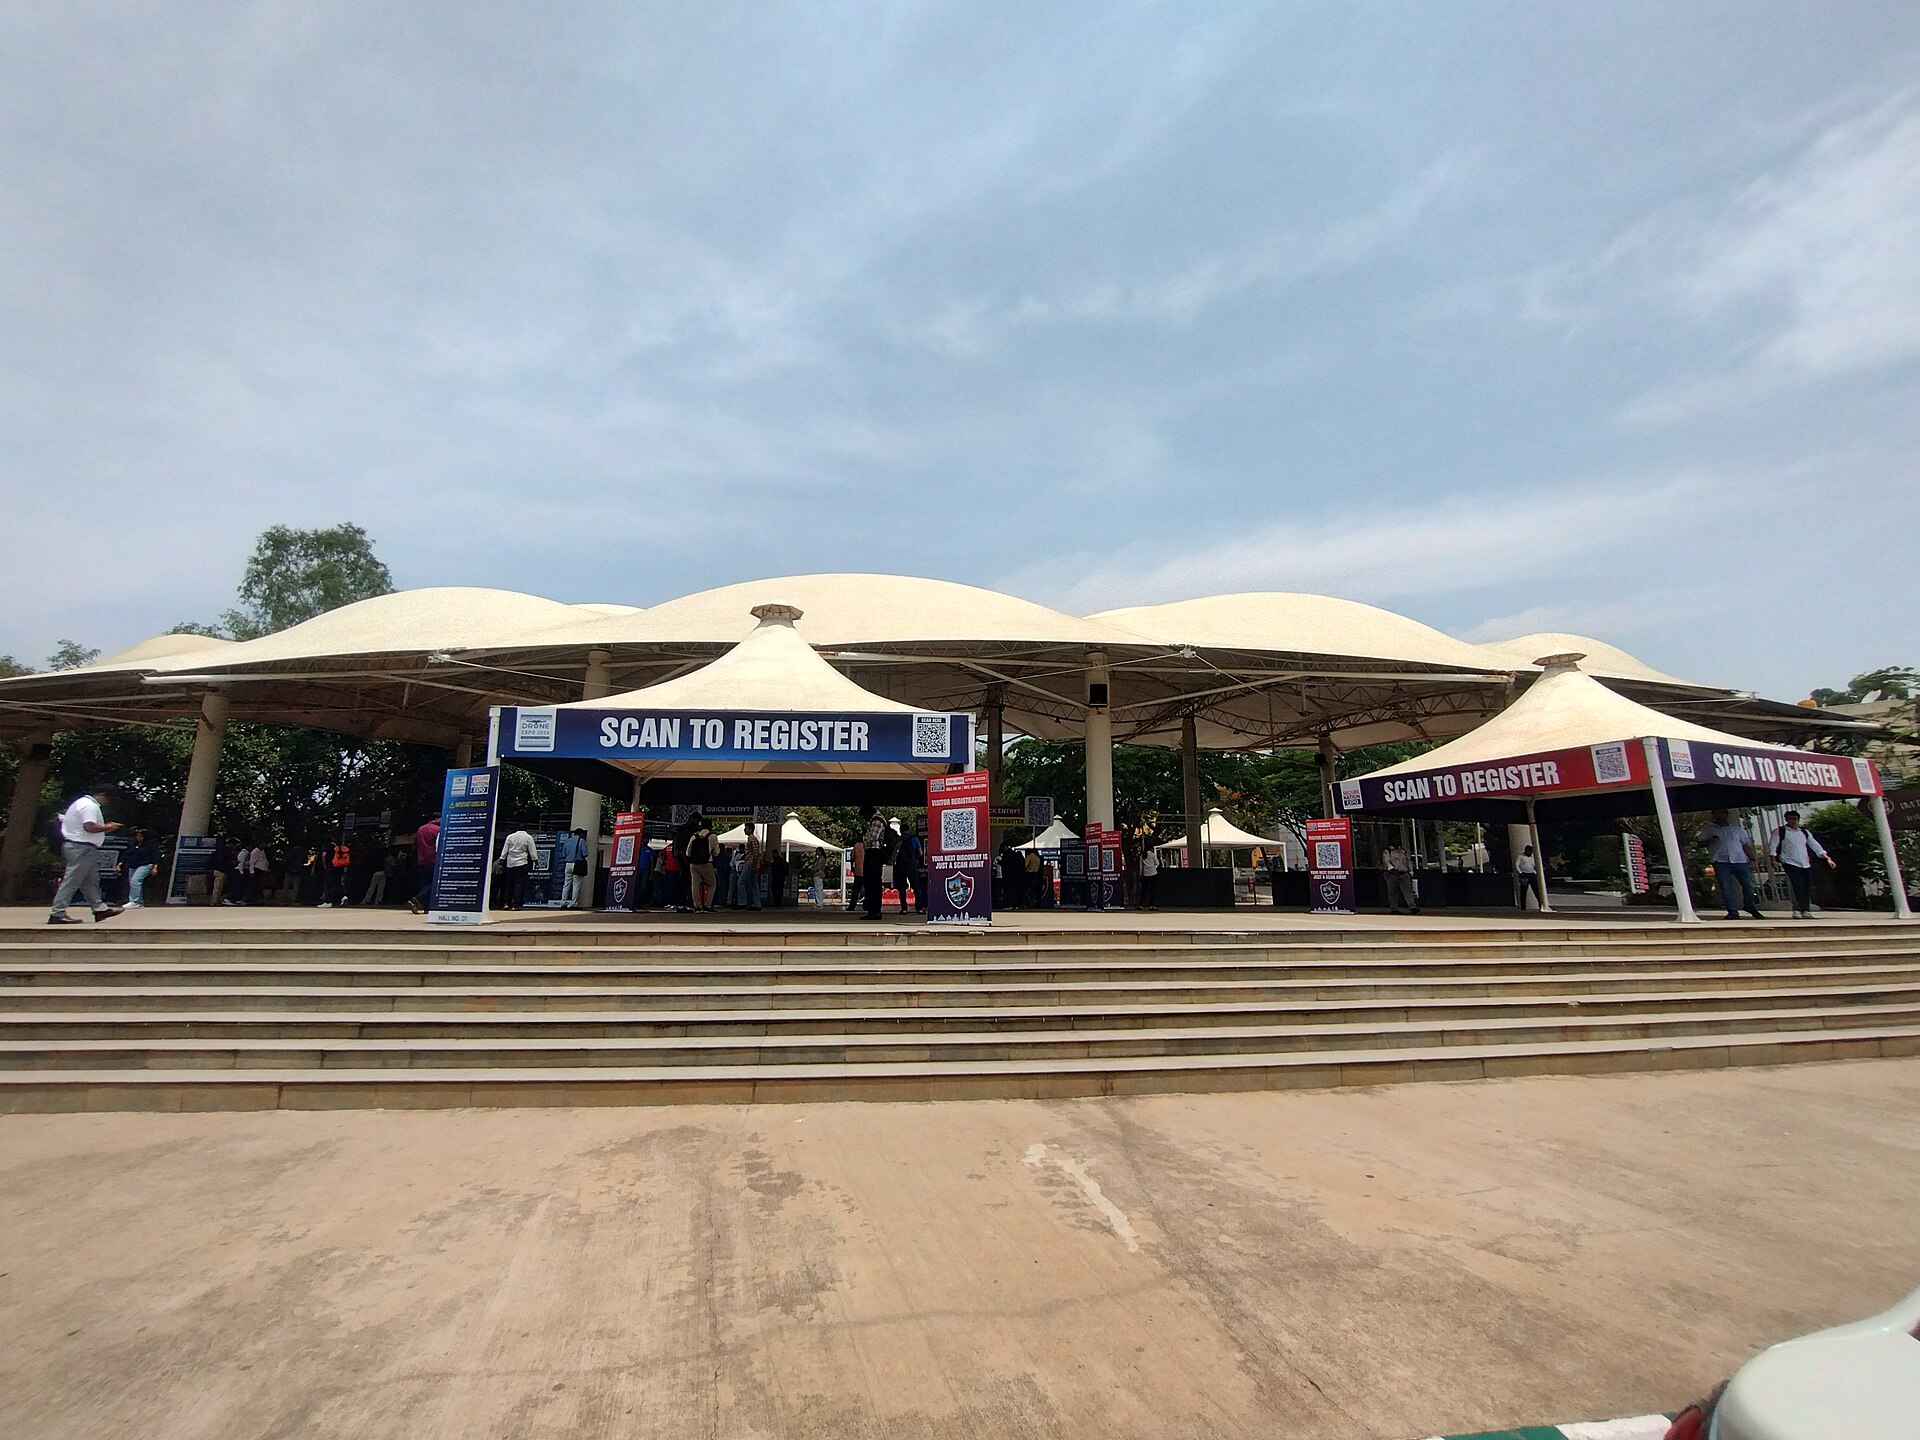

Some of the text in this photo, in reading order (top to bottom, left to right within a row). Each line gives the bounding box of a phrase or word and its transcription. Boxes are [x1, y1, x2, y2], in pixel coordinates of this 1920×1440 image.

[522, 722, 550, 730] DRONE
[599, 716, 869, 751] SCAN TO REGISTER
[1675, 765, 1690, 773] EXPO
[1713, 752, 1842, 788] SCAN TO REGISTER
[1383, 761, 1561, 803] SCAN TO REGISTER
[931, 795, 987, 806] VISITOR REGISTRATION
